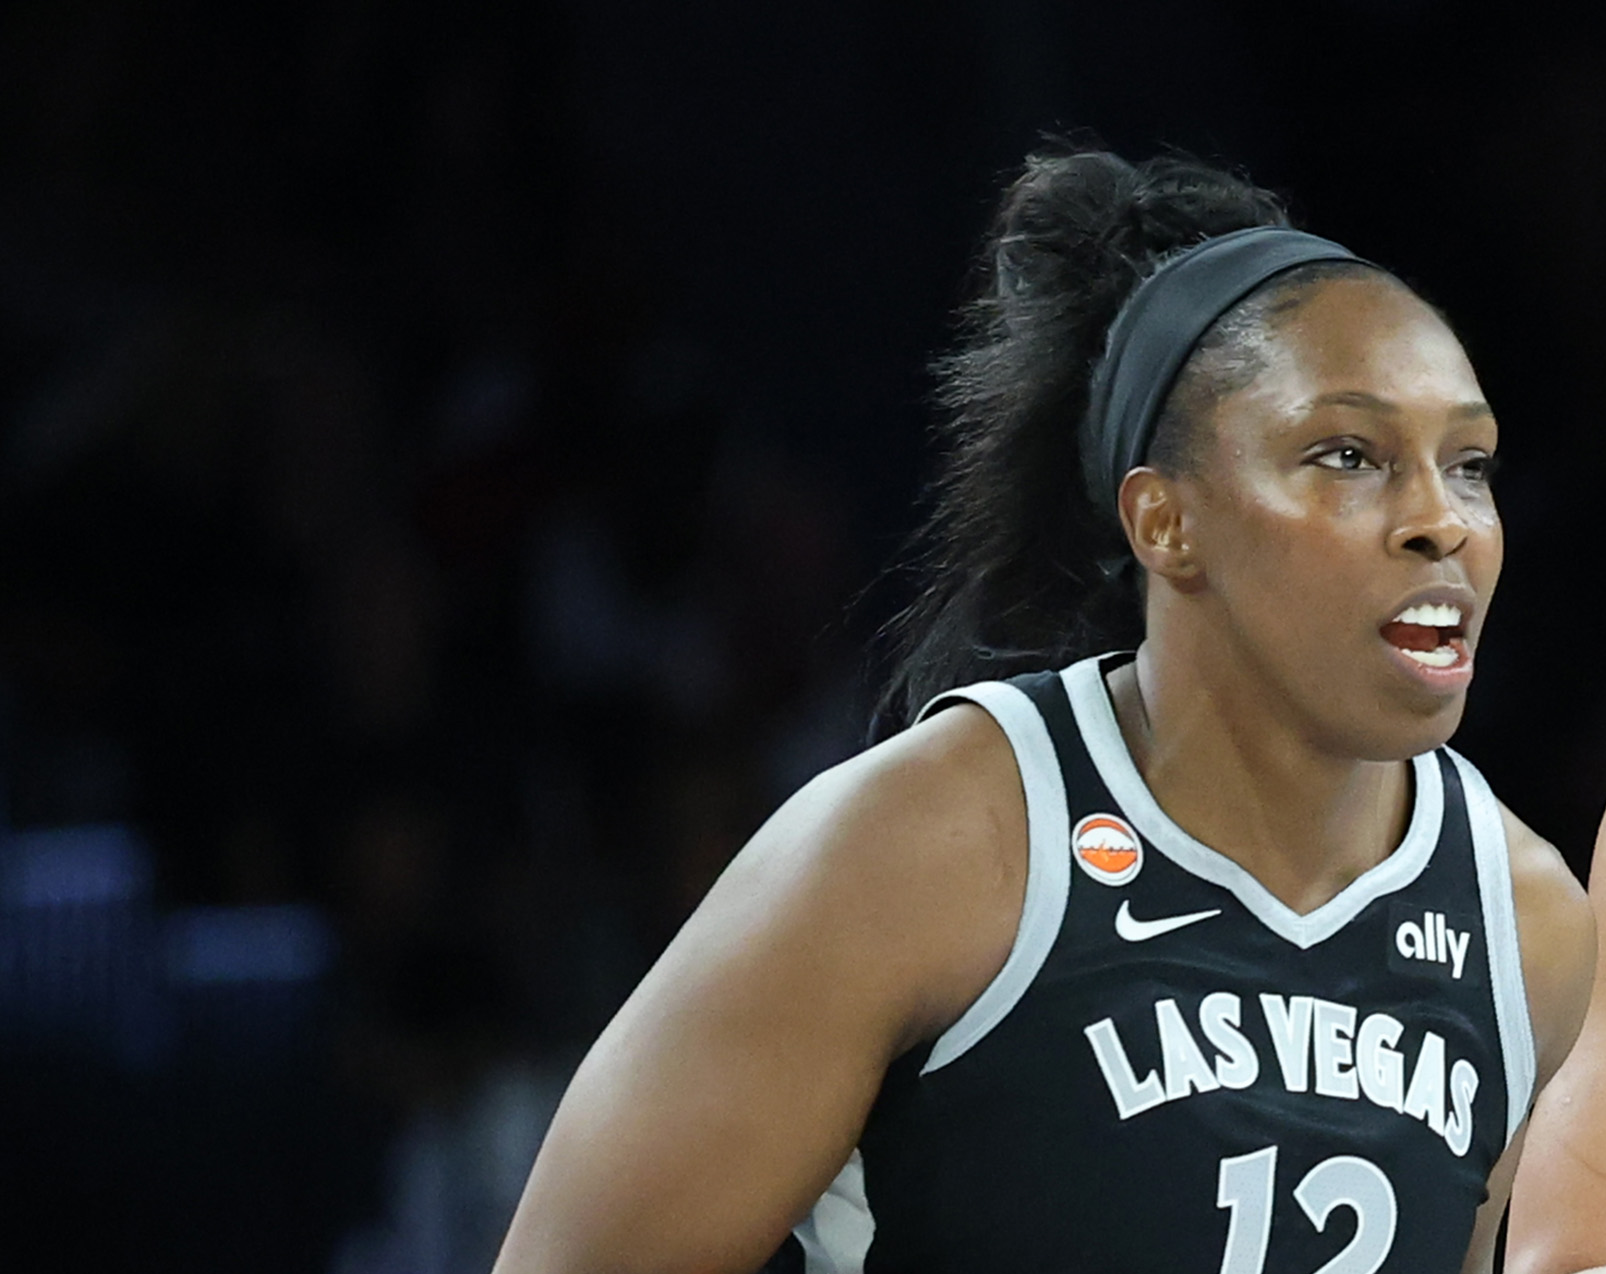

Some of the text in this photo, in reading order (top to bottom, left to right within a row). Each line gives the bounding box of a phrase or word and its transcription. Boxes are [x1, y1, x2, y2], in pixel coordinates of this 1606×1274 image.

[1395, 912, 1470, 979] ally
[1084, 992, 1479, 1158] LAS VEGAS
